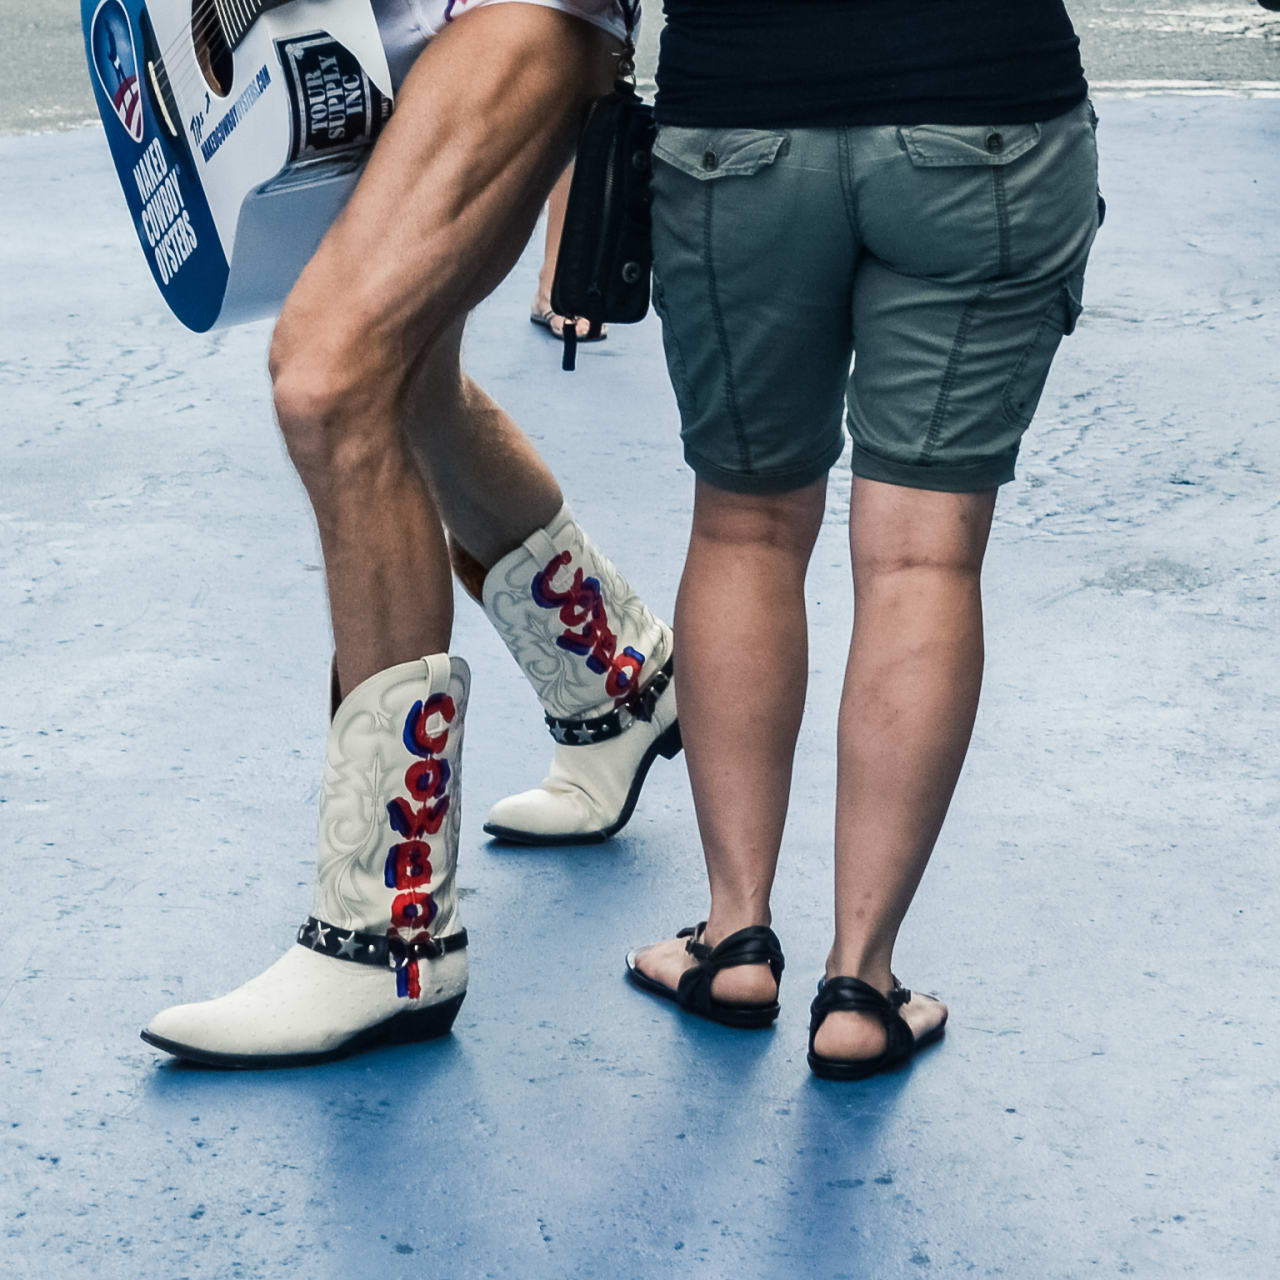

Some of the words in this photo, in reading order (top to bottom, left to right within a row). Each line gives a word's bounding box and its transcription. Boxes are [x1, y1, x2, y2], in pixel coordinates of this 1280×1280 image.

[304, 68, 329, 135] TOUR
[318, 55, 347, 140] SUPPLY
[341, 73, 364, 116] INC
[132, 136, 169, 206] NAKED
[141, 167, 185, 249] COWBOY
[154, 209, 199, 286] OYSTERS
